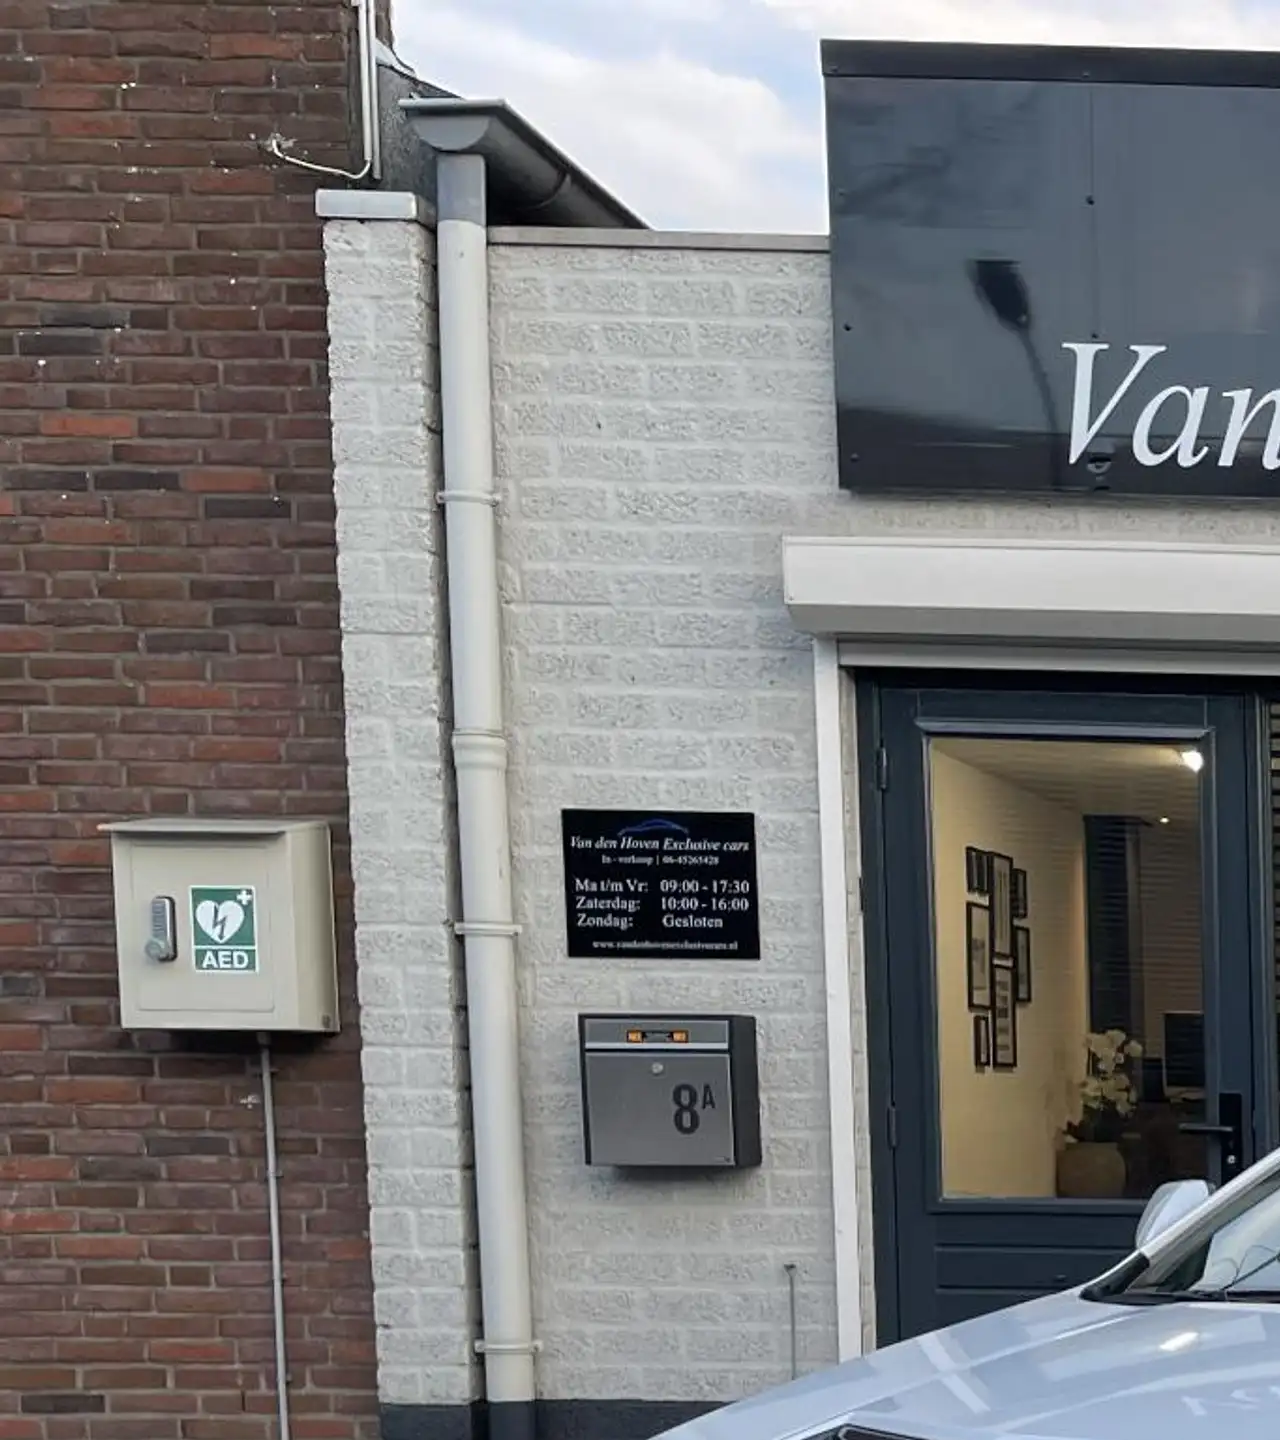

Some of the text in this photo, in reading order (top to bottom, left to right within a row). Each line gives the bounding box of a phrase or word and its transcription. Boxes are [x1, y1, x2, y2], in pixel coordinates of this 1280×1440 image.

[570, 836, 750, 851] Van den Hoven Exclusive cars
[575, 878, 598, 892] Ma
[600, 879, 624, 892] t/m
[626, 879, 649, 892] Vr:
[660, 879, 699, 893] 09:00
[712, 880, 750, 893] 17:30
[575, 896, 641, 912] Zaterdag:
[661, 897, 699, 911] 10:00
[712, 897, 750, 911] 16:00
[577, 913, 723, 930] Zondag: Gesloten
[202, 950, 249, 969] AED
